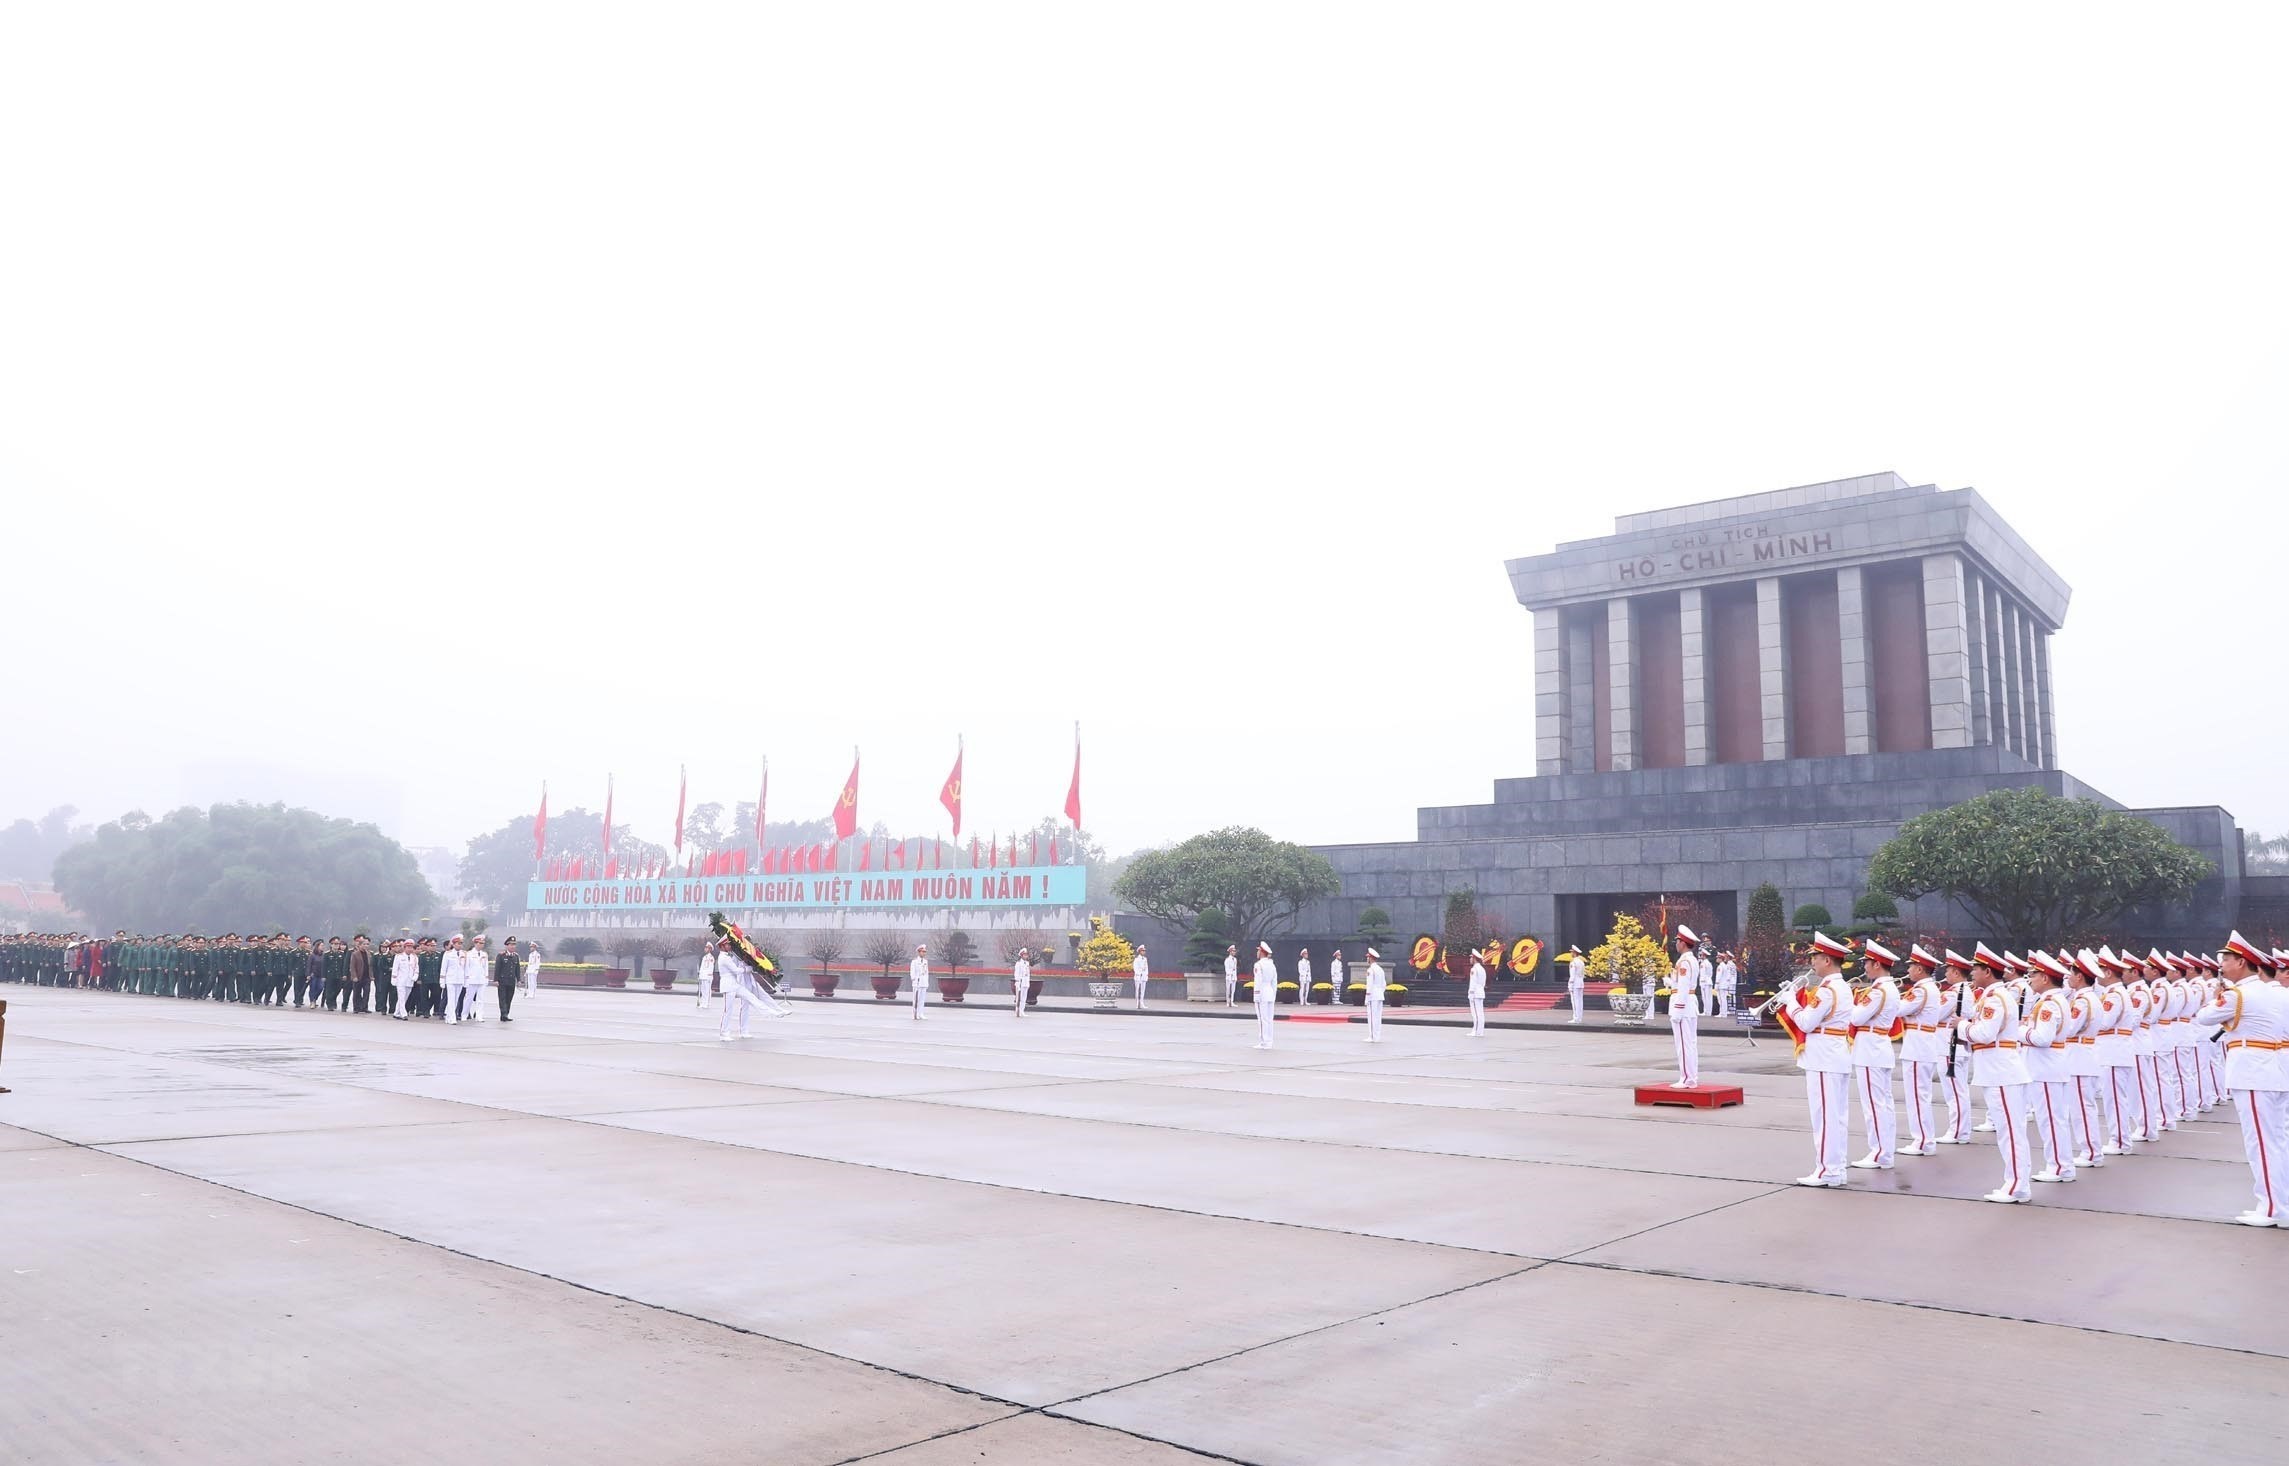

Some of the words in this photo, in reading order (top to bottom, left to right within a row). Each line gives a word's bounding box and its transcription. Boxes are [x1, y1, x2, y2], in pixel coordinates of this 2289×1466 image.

[1724, 526, 1768, 544] TỊCH
[545, 883, 578, 905] NƯỚC
[583, 883, 619, 908] CỘNG
[658, 881, 677, 904] XÃ
[683, 880, 708, 907] HỘI
[715, 877, 746, 903] CHỦ
[753, 877, 804, 903] NGHĨA
[814, 876, 852, 905] VIỆT
[860, 879, 903, 901] NAM
[912, 872, 972, 900] MUÔN
[982, 871, 1031, 899] NĂM
